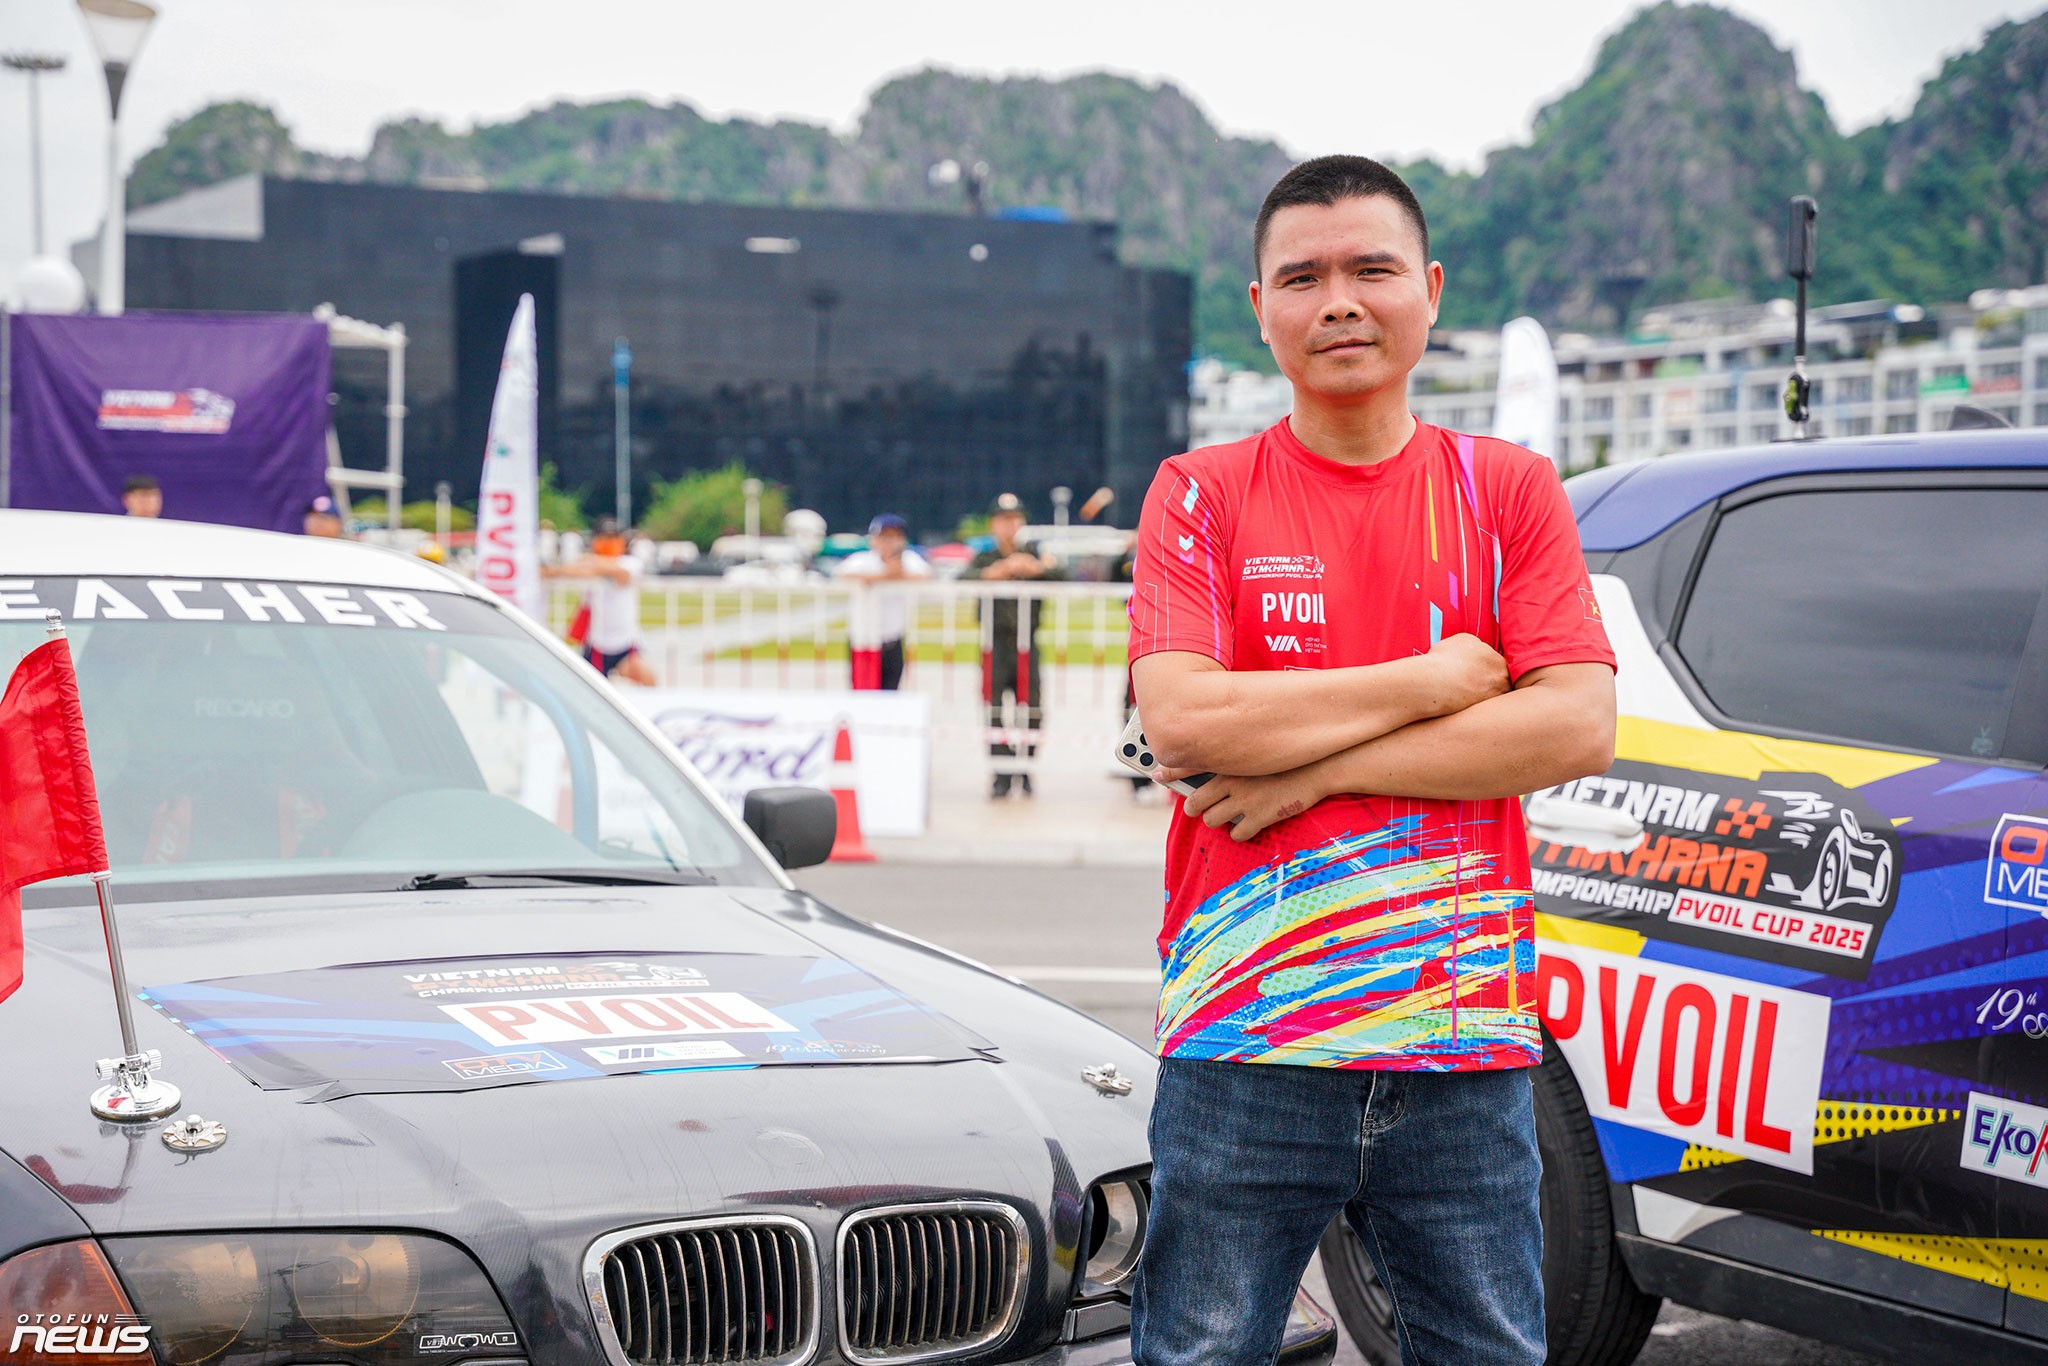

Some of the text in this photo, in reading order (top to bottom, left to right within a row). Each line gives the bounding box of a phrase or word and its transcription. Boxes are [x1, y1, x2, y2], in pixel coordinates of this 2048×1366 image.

[485, 492, 516, 606] PVOI
[1243, 564, 1304, 575] GYMKHANA
[1245, 556, 1290, 566] VIETNAM
[1262, 592, 1326, 625] PVOIL
[1675, 896, 1745, 930] PVOIL
[1752, 912, 1804, 938] CUP
[1808, 922, 1866, 952] 2025
[402, 966, 560, 983] VIETNAM
[410, 973, 624, 991] GYMKHANA
[418, 983, 567, 998] CHAMPIONSHIP
[463, 995, 774, 1041] PVOIL
[458, 1060, 552, 1078] MEDIA
